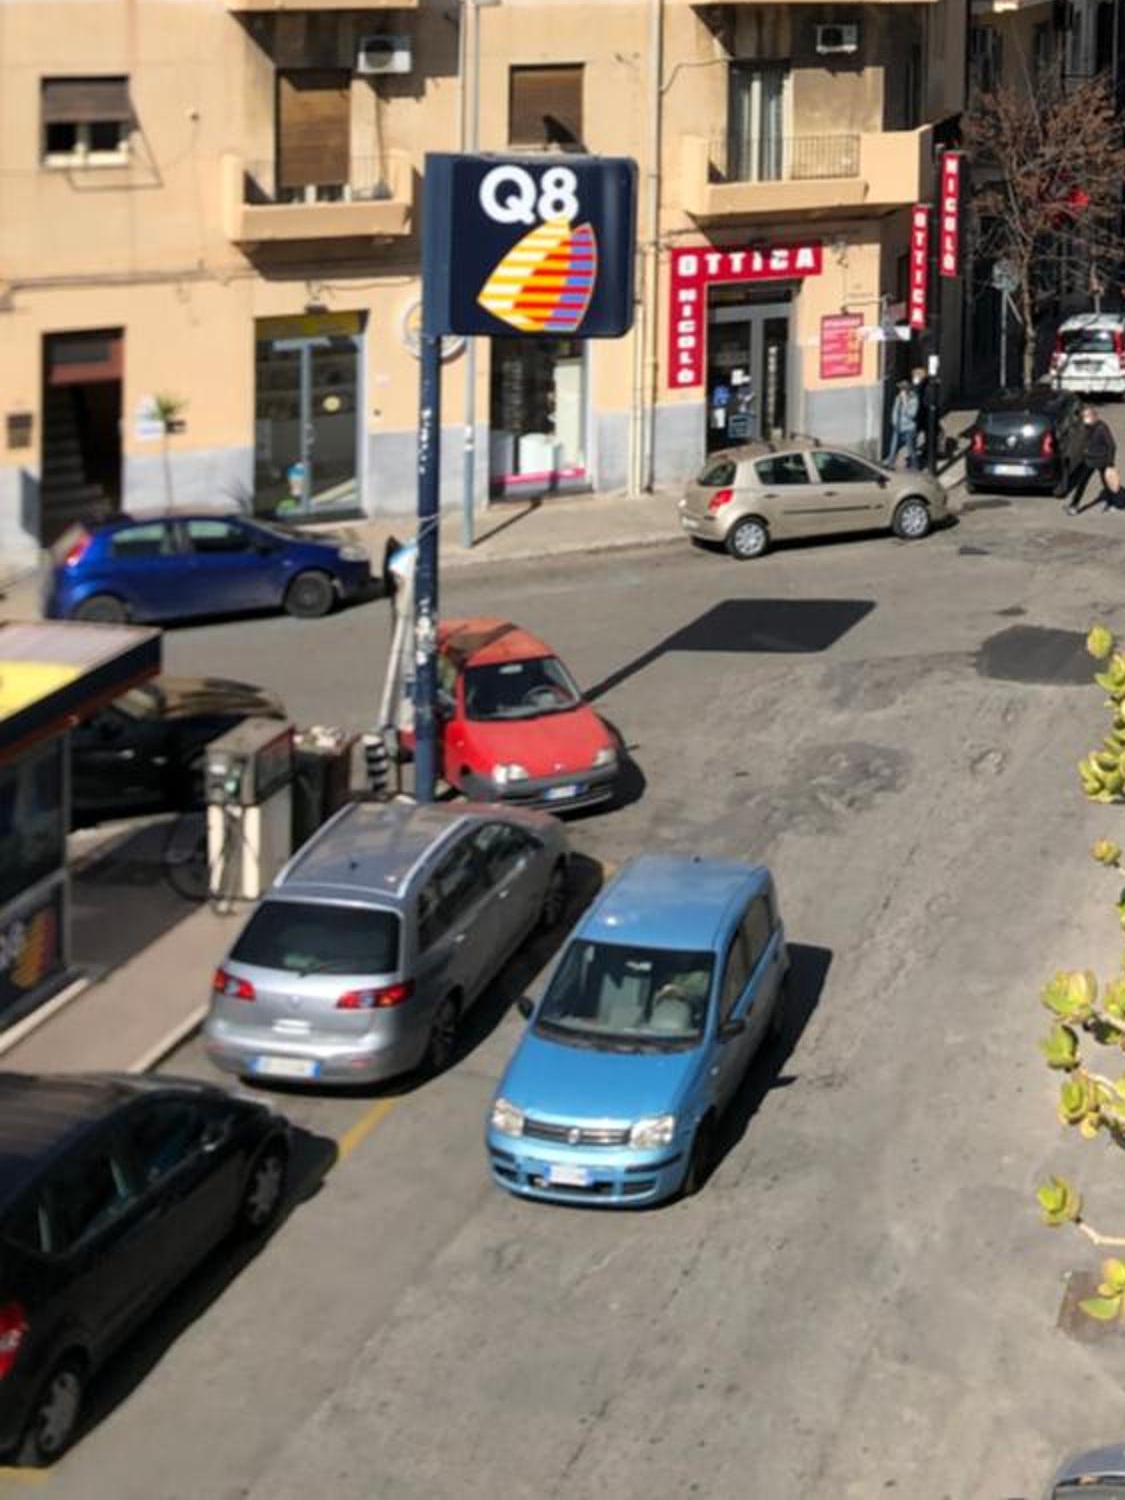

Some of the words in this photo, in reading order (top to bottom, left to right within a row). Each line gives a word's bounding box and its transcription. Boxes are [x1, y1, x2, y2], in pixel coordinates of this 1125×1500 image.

[479, 165, 580, 224] Q8
[677, 247, 816, 277] OTTICA
[911, 211, 928, 322] OTTICA
